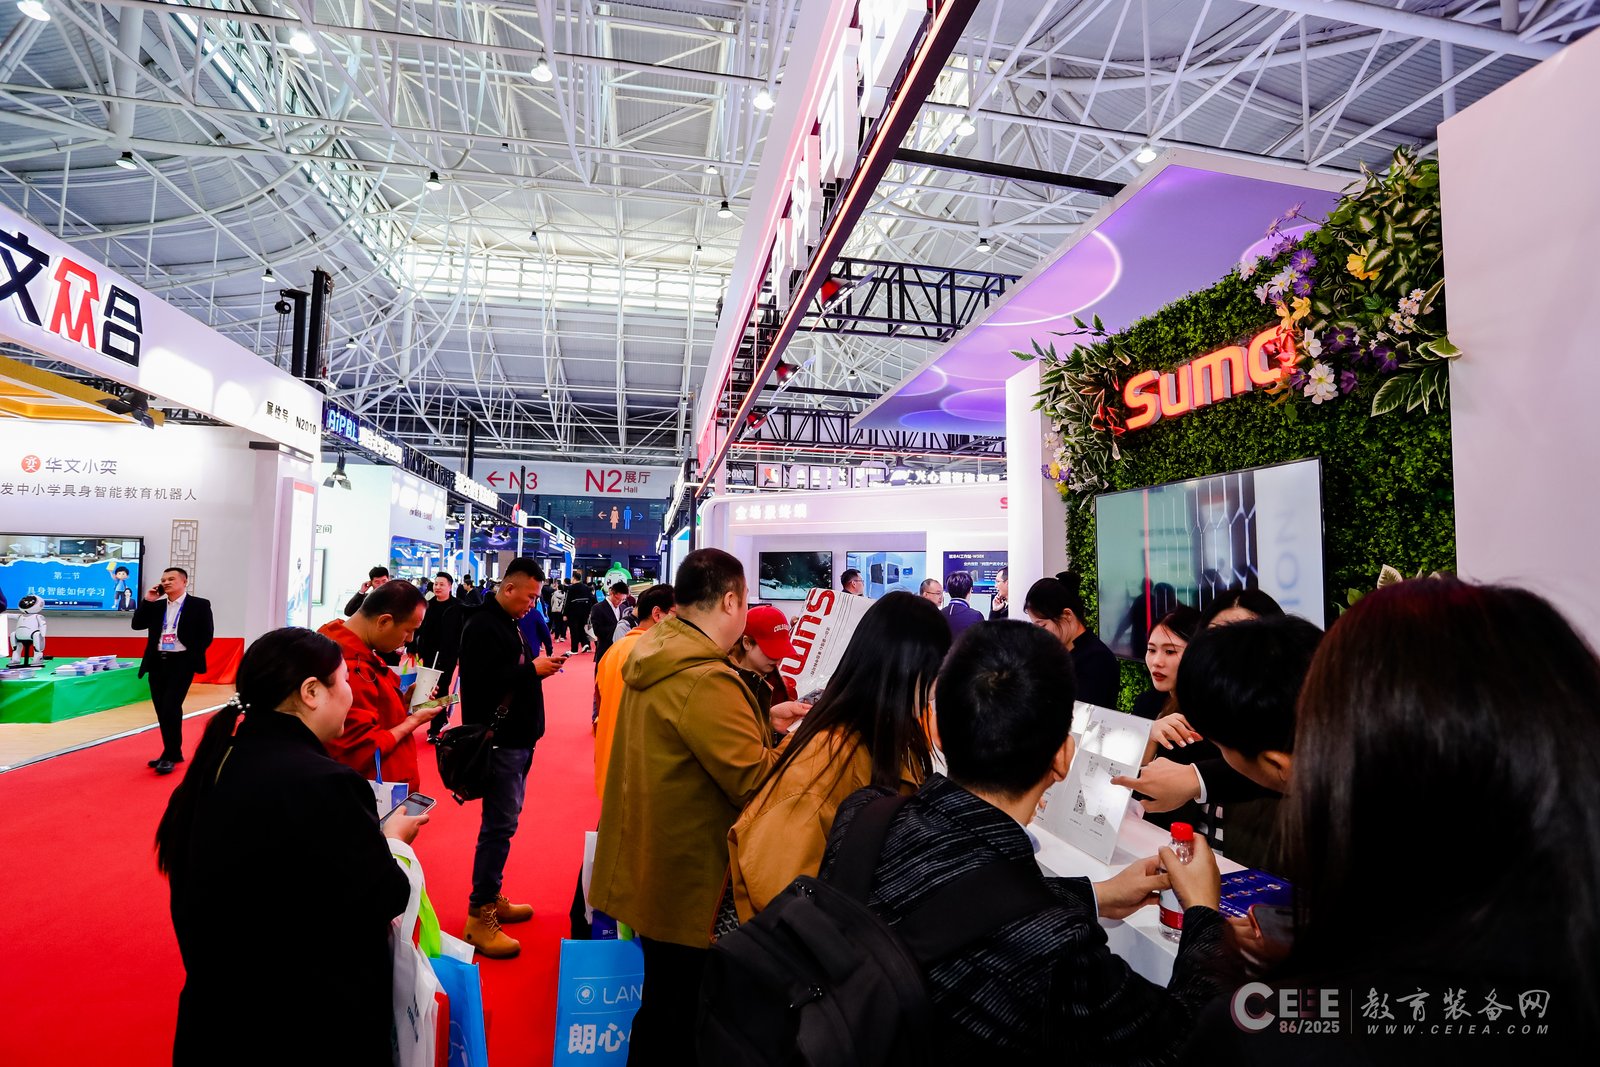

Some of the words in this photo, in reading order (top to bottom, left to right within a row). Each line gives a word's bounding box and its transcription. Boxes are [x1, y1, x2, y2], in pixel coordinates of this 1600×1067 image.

[265, 400, 289, 423] 展位号
[295, 415, 317, 435] N2010
[45, 456, 118, 475] 华文小奕
[508, 471, 538, 491] N3
[584, 468, 622, 494] N2
[624, 470, 651, 484] 展厅
[624, 485, 638, 494] Hall
[0, 481, 198, 502] 发中小学具身智能教育机器人
[53, 571, 81, 581] 第二节
[27, 586, 106, 597] 具身智能如何学习
[567, 1022, 631, 1055] 朗心
